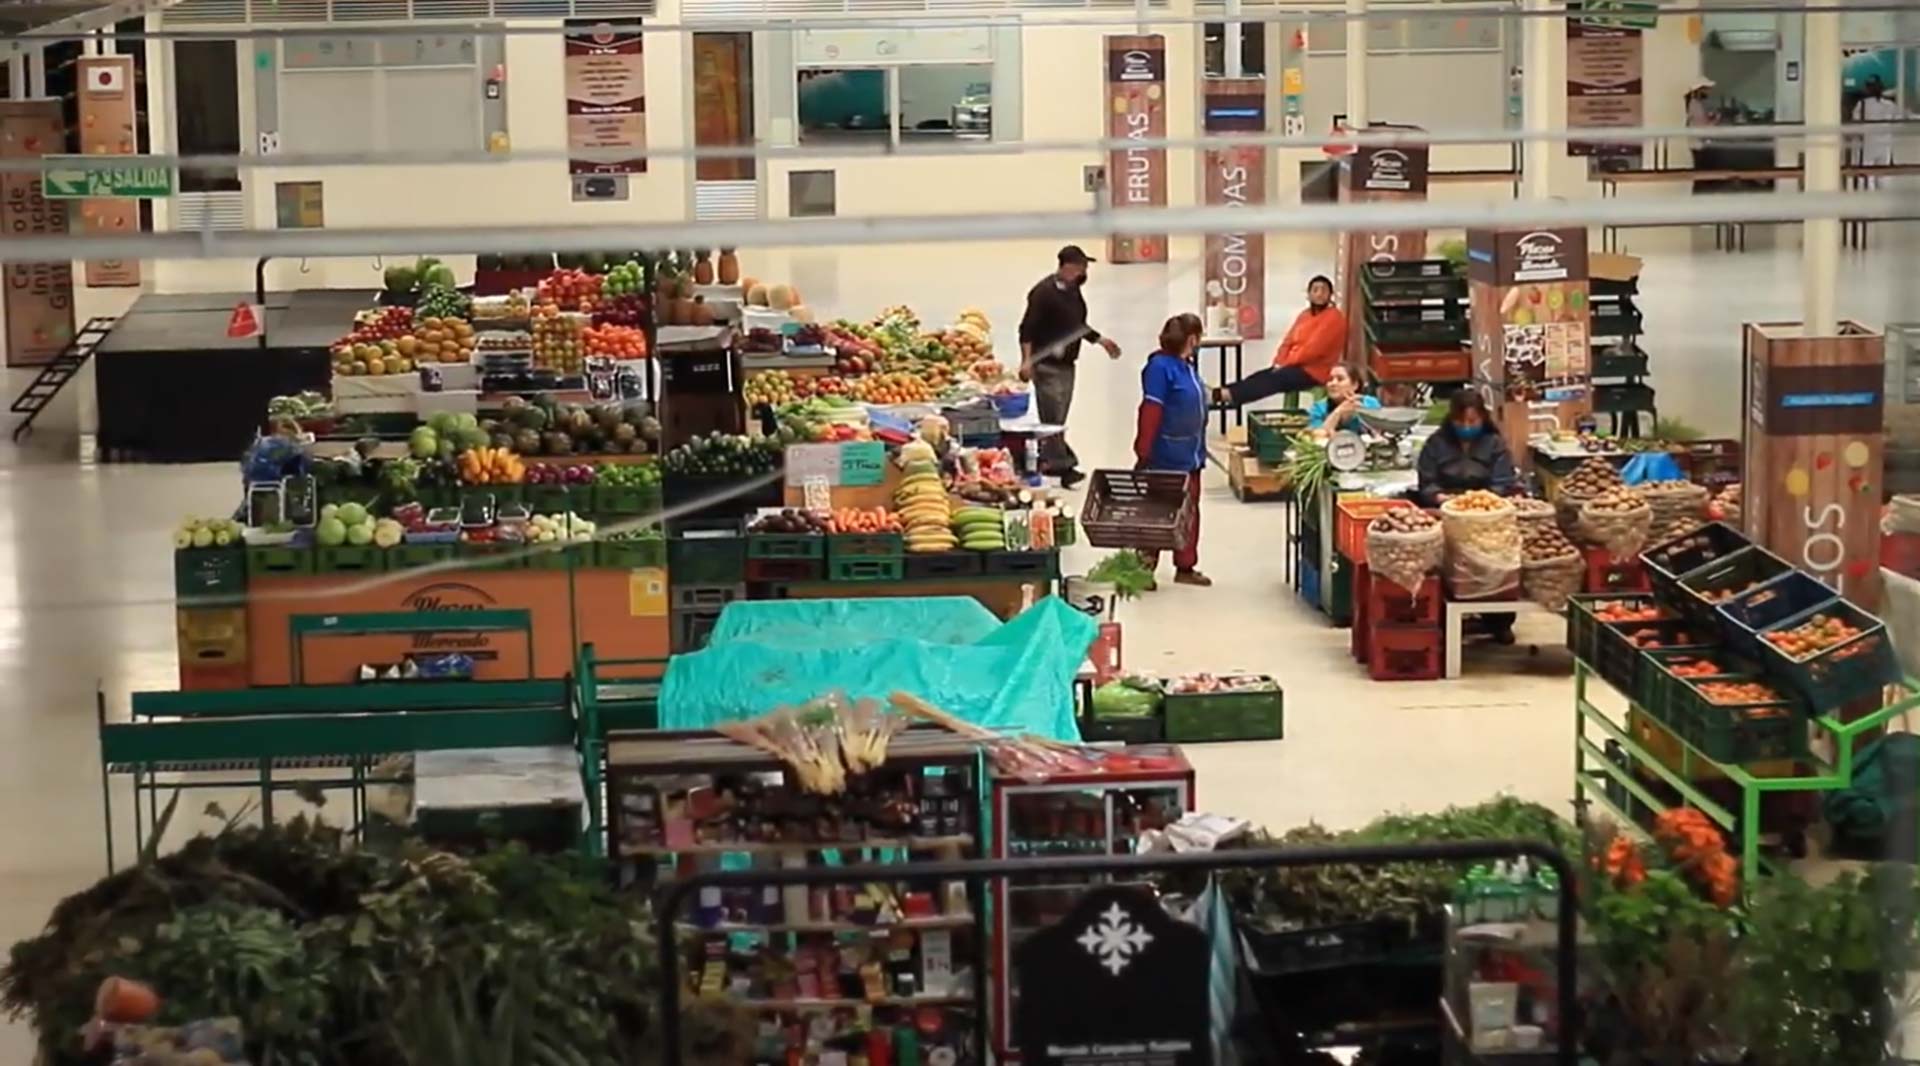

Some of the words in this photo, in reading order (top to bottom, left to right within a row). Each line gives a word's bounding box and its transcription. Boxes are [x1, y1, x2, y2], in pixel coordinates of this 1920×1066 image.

[114, 166, 170, 189] SALIDA
[1127, 112, 1150, 203] FRUTAS
[1222, 167, 1247, 295] COMAS
